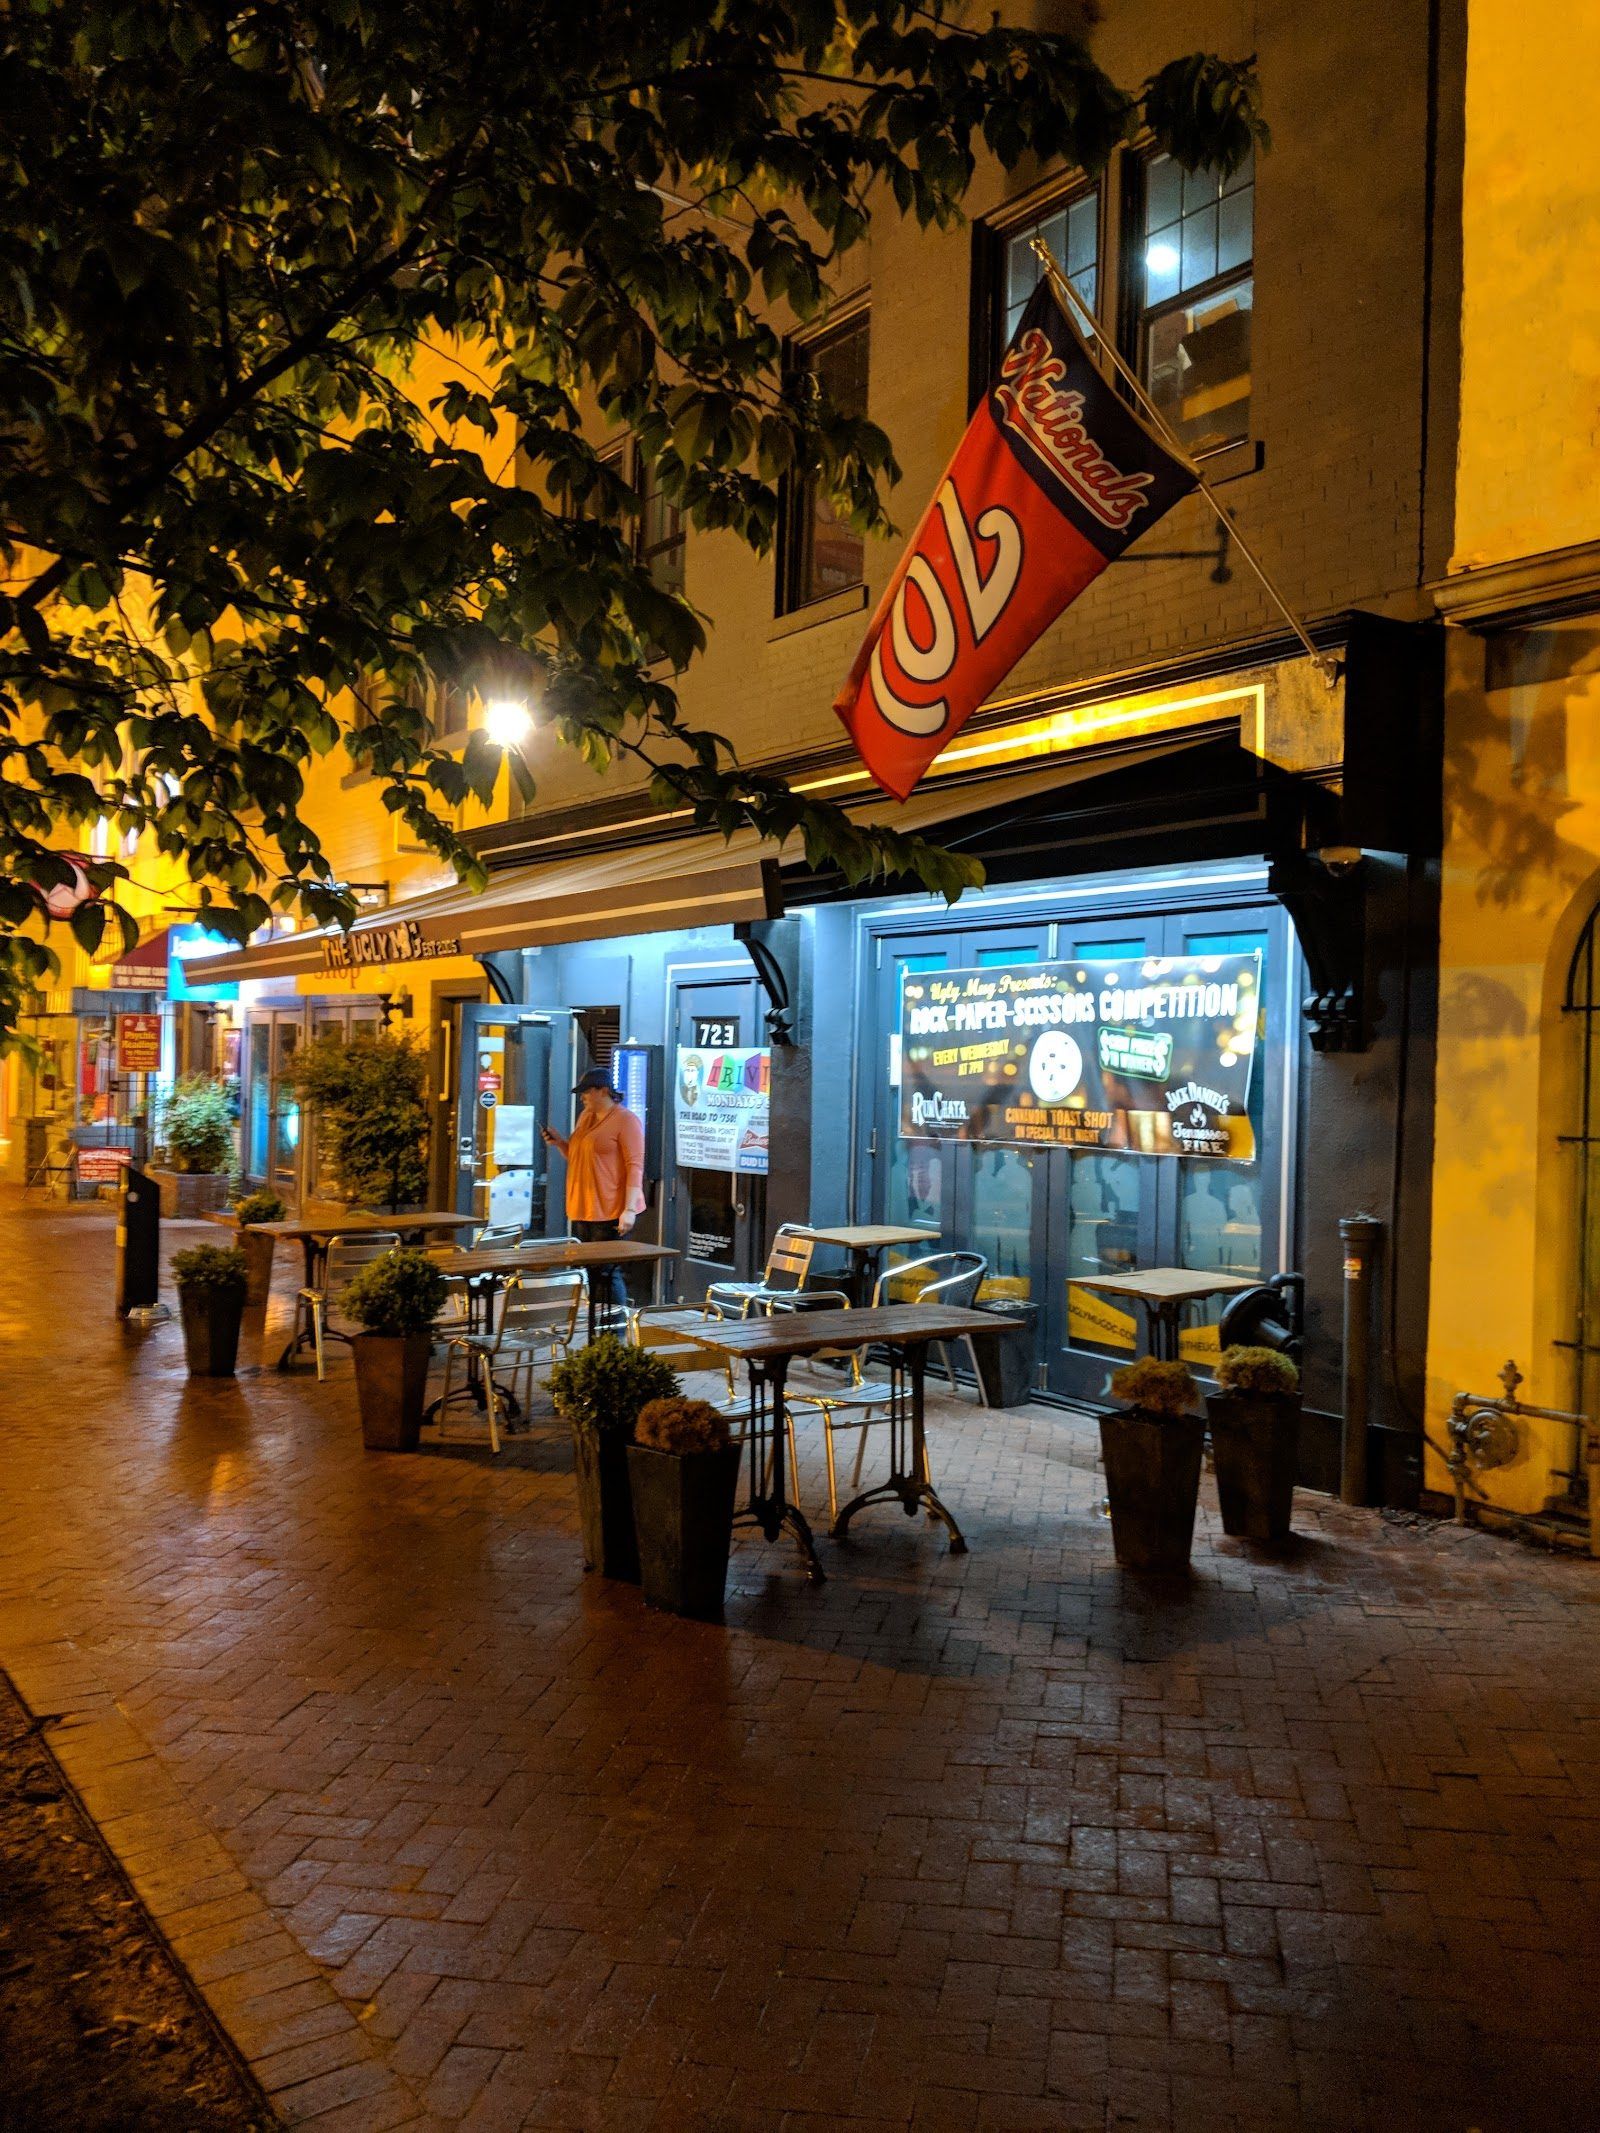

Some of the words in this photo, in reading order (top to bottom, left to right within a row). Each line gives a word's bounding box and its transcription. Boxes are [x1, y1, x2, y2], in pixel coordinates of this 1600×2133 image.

[999, 328, 1155, 528] Nationals
[321, 933, 350, 967] THE
[351, 932, 387, 963] UGLY
[1099, 983, 1238, 1021] COMPETITION
[700, 1024, 734, 1045] 723
[1052, 1109, 1081, 1126] TOAST
[1084, 1111, 1113, 1129] SHOT
[1026, 1126, 1056, 1140] SPECIAL
[1183, 1140, 1225, 1154] FIRE
